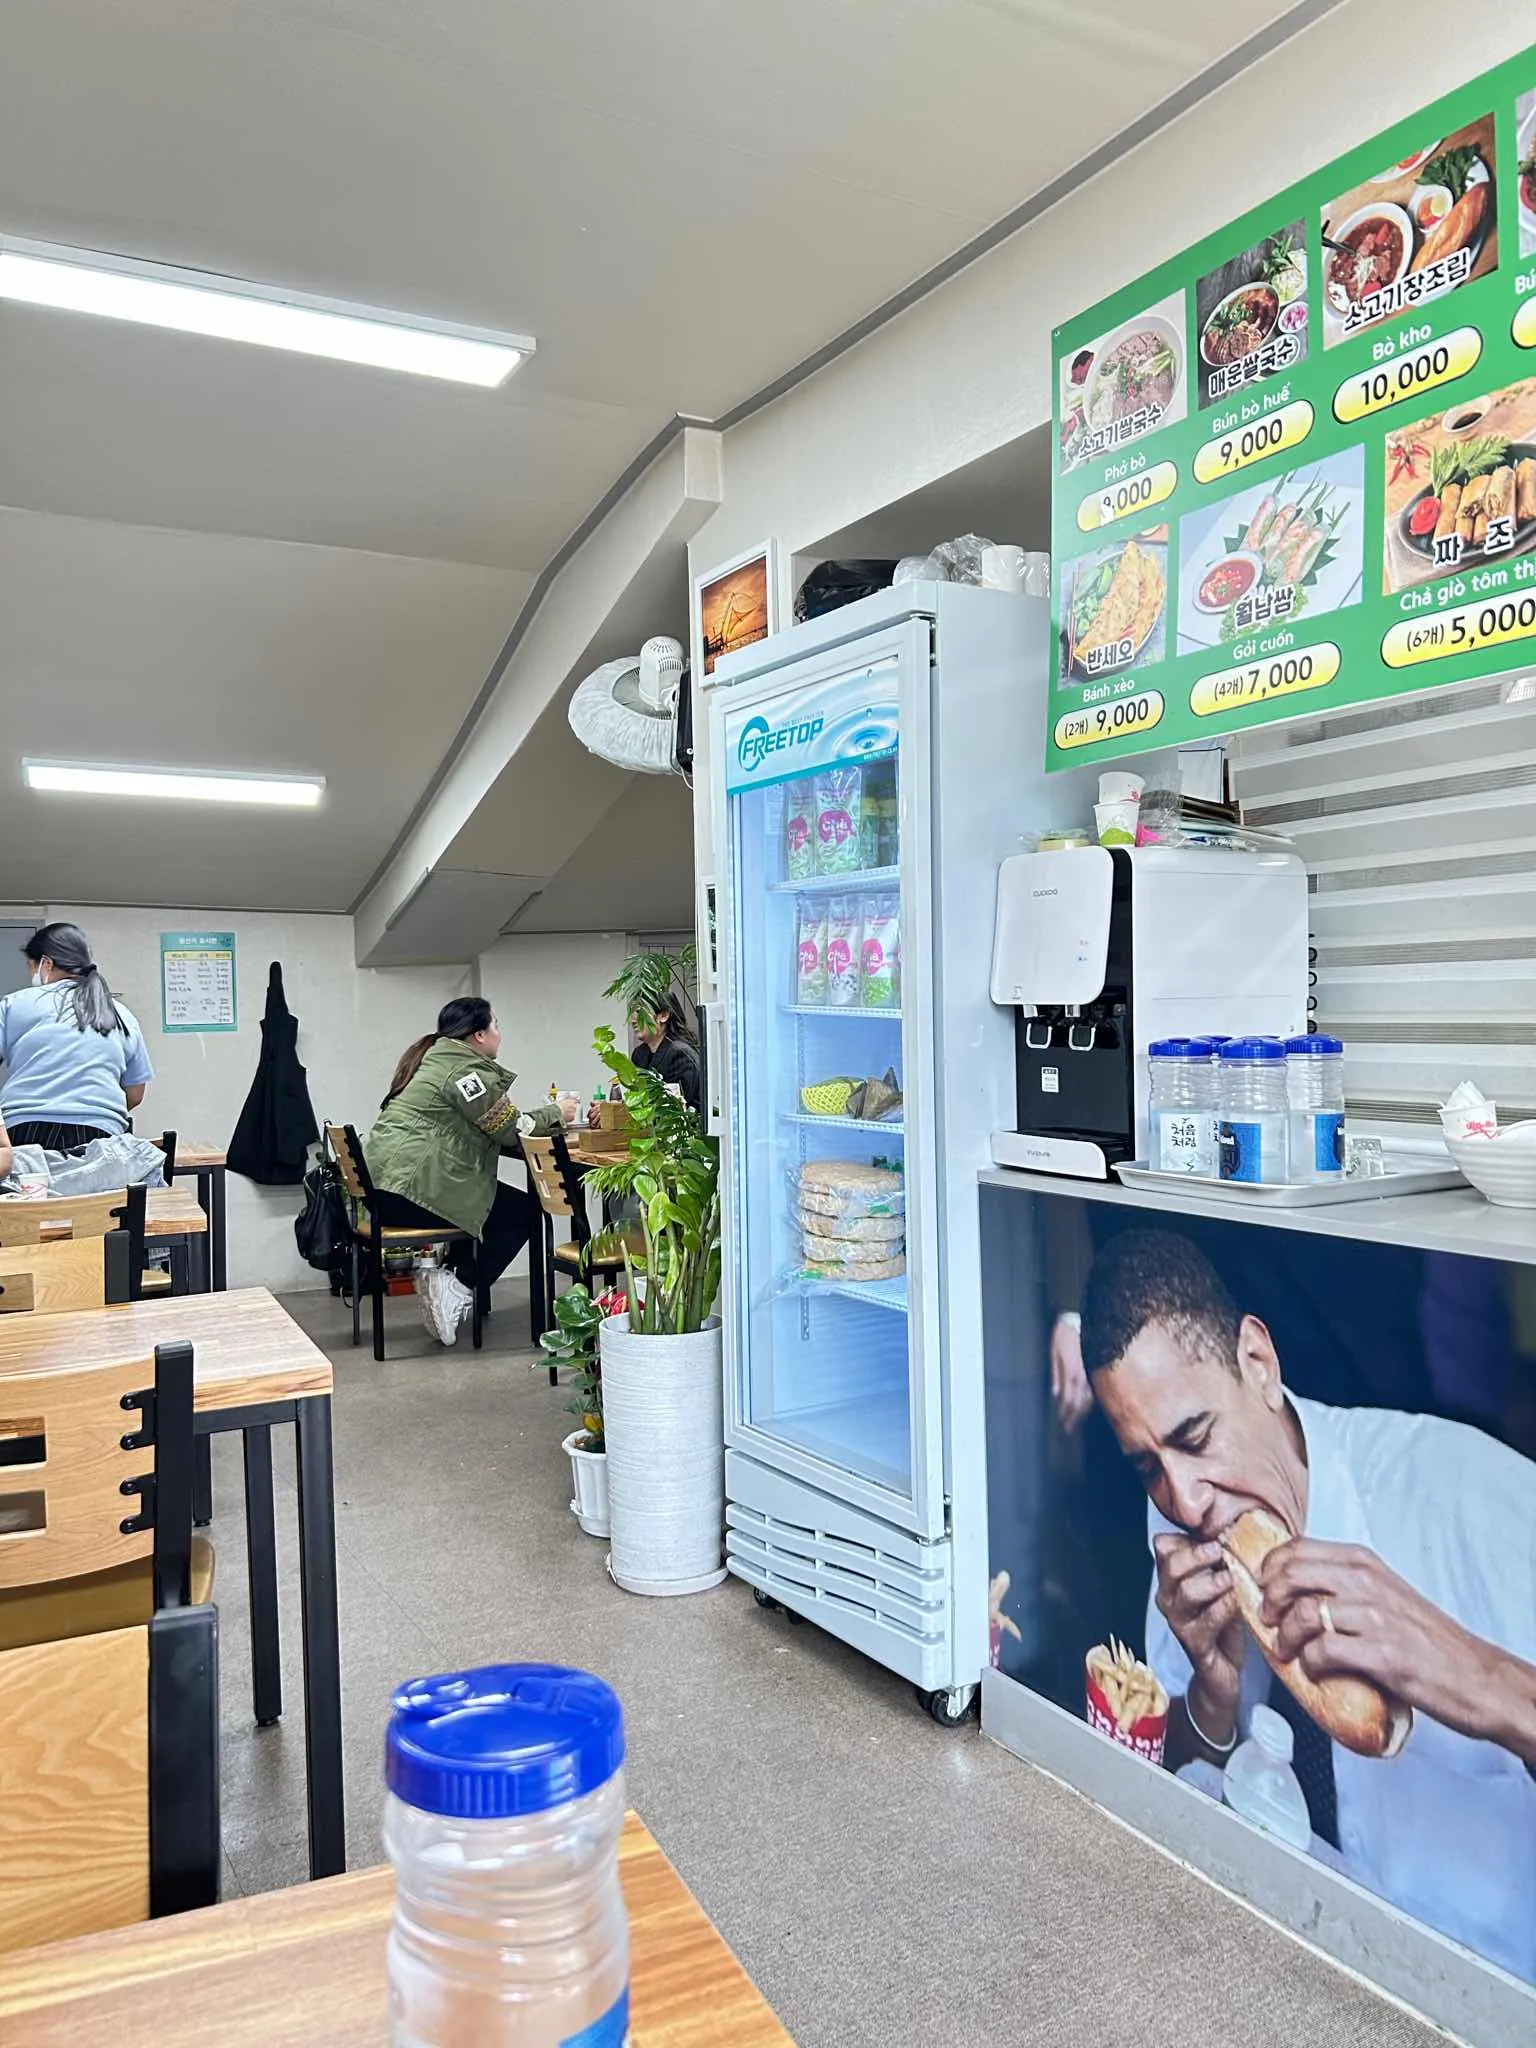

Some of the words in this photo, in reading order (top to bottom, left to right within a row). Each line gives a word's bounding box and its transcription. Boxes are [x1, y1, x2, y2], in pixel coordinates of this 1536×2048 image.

[1344, 251, 1468, 332] 소고기장조림
[1515, 264, 1536, 296] Bú
[1372, 335, 1395, 361] Bò
[1400, 324, 1433, 350] kho
[1209, 337, 1295, 397] 매운쌀국수
[1361, 346, 1450, 406] 10,000
[1212, 412, 1239, 434] Bún
[1241, 399, 1261, 420] bò
[1263, 381, 1292, 411] huế
[1078, 402, 1163, 460] 소고기쌀국수
[1220, 418, 1283, 469] 9,000
[1104, 459, 1129, 482] Phở
[1130, 451, 1147, 472] bò
[1487, 519, 1511, 550] 조
[1235, 586, 1296, 627] 월남쌈
[1400, 586, 1432, 611] Chả
[1437, 577, 1466, 606] giò
[1472, 570, 1509, 592] tôm
[1233, 638, 1257, 661] Gỏi
[1260, 628, 1294, 653] cuốn
[1407, 623, 1445, 653] (6개)
[1451, 598, 1536, 648] 5,000
[1086, 639, 1133, 672] 반세오
[1083, 683, 1111, 703] Bánh
[1113, 677, 1136, 695] xèo
[1214, 675, 1244, 701] (4개)
[1248, 654, 1314, 698] 7,000
[742, 718, 825, 761] FREETOP
[1064, 717, 1089, 740] (2개)
[1096, 698, 1149, 736] 9,000
[1170, 1122, 1198, 1137] 처음
[1170, 1134, 1198, 1149] 처럼
